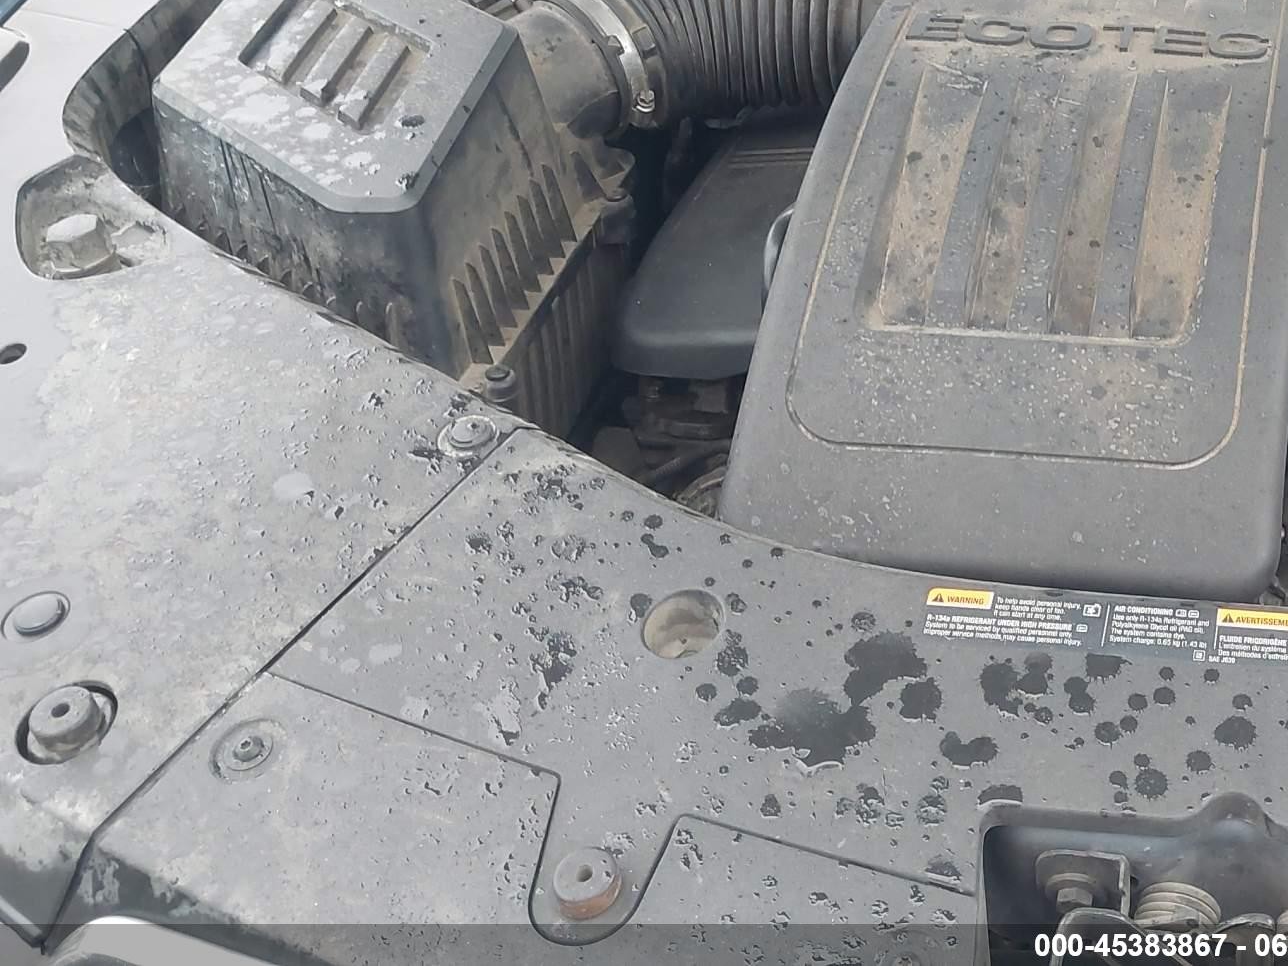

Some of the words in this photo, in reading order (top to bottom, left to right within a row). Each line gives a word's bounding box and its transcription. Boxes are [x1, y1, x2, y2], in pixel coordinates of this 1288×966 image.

[905, 13, 1270, 59] ECOTEC
[947, 595, 984, 604] WARNING
[1127, 606, 1173, 615] CONDITIONING
[927, 614, 950, 622] R-134a
[952, 615, 996, 625] REFRIGERANT
[998, 619, 1019, 627] UNDER
[1021, 620, 1037, 628] HIGH
[1039, 621, 1072, 630] PRESSURE
